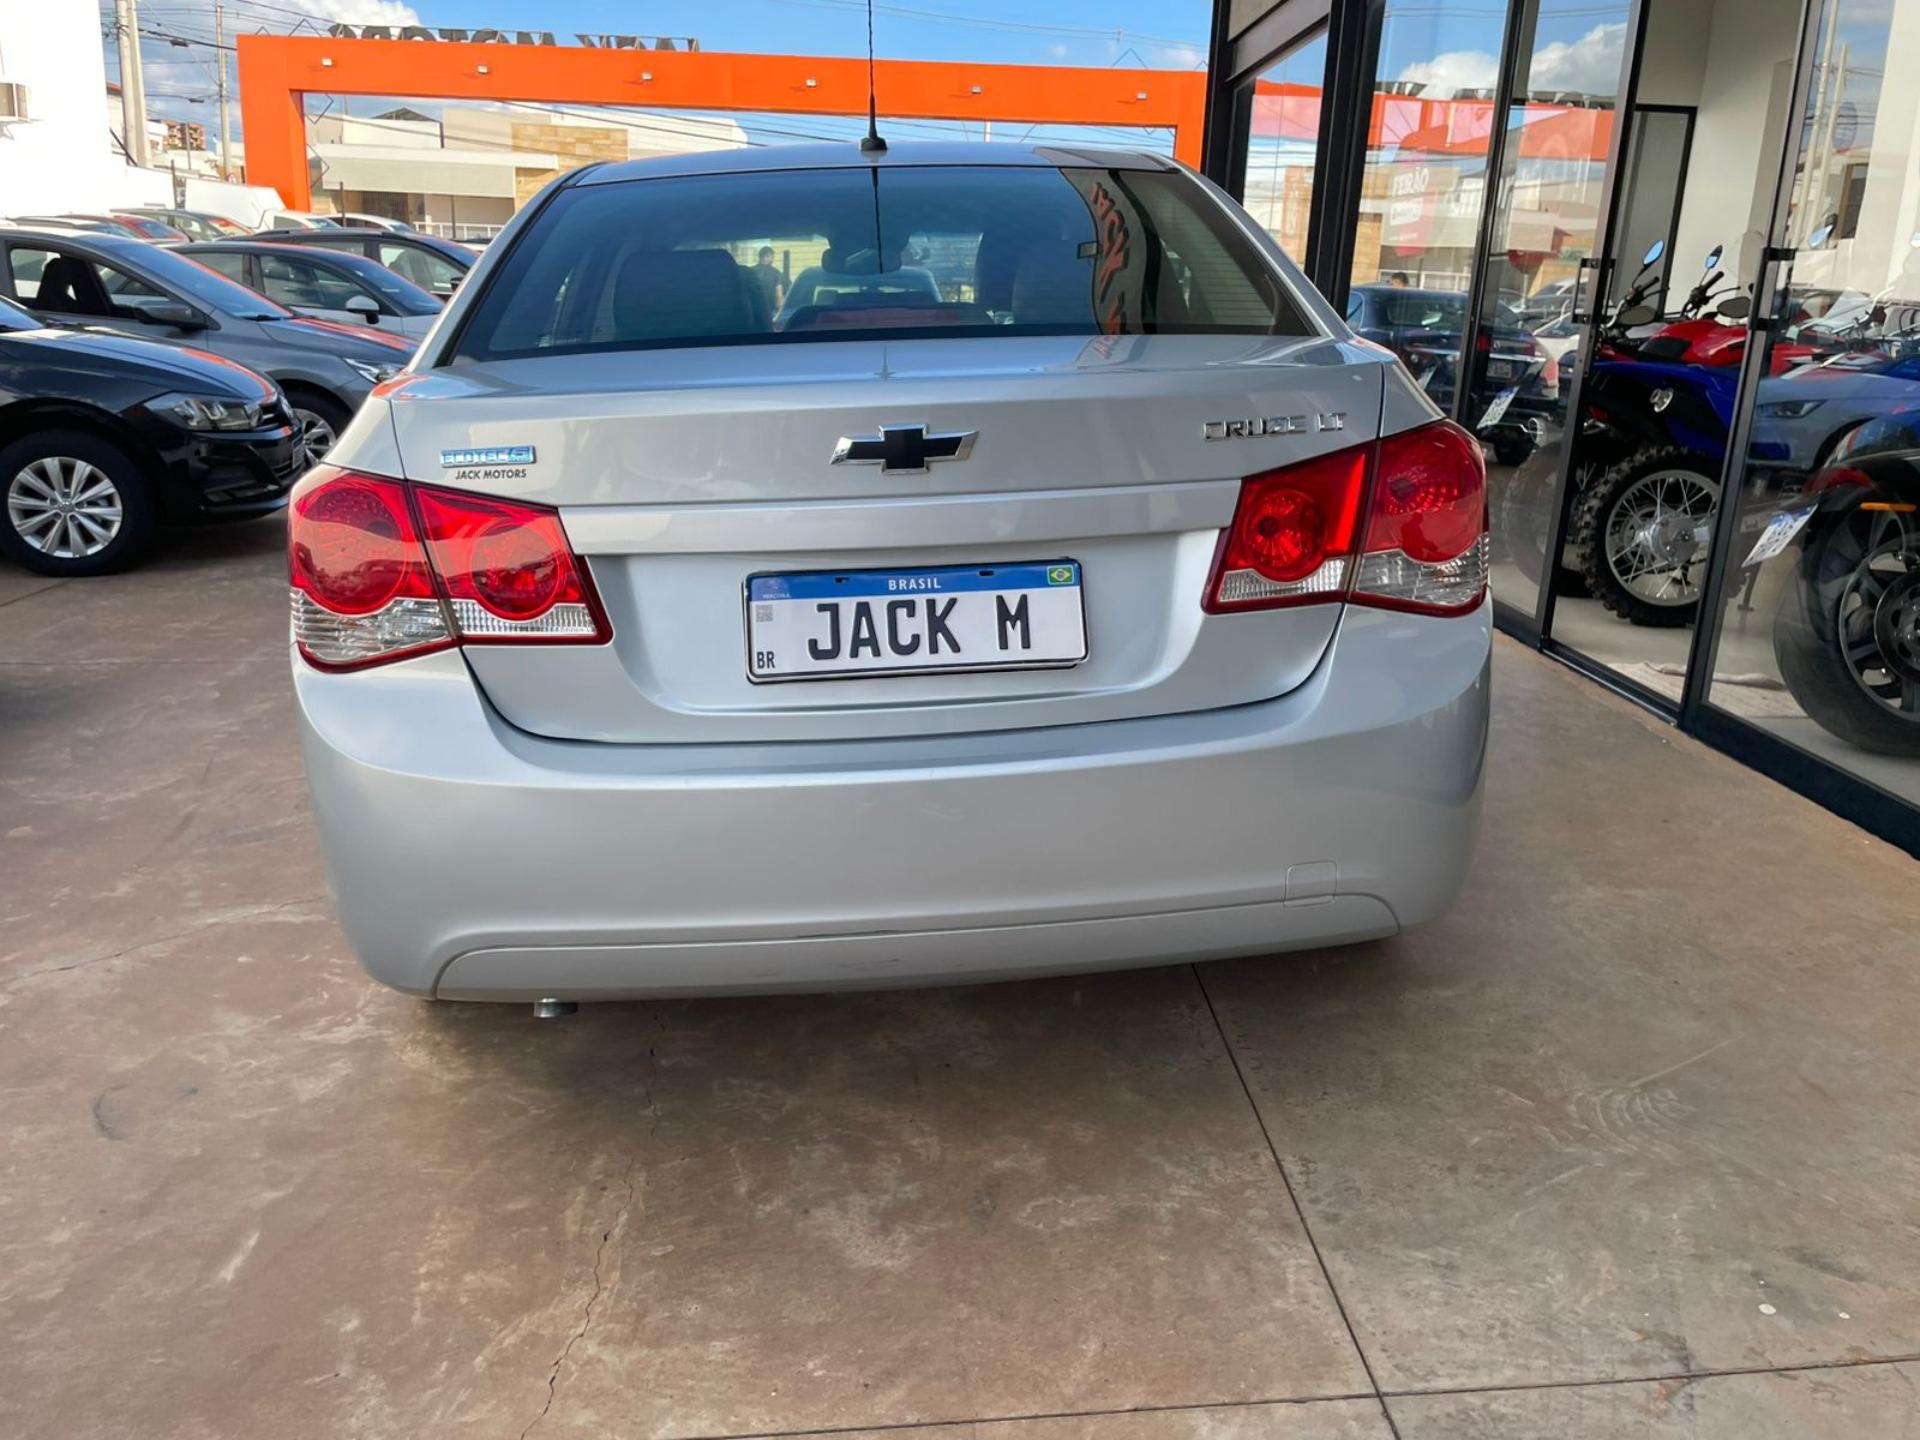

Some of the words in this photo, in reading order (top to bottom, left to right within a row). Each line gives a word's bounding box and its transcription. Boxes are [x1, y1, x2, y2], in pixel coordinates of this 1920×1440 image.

[1203, 414, 1307, 443] CRUZE
[1316, 411, 1348, 433] LT
[455, 470, 480, 480] JACK
[483, 468, 527, 480] MOTORS
[888, 577, 941, 591] BRASIL
[808, 597, 961, 661] JACK
[995, 593, 1031, 651] M
[756, 650, 776, 670] BR
